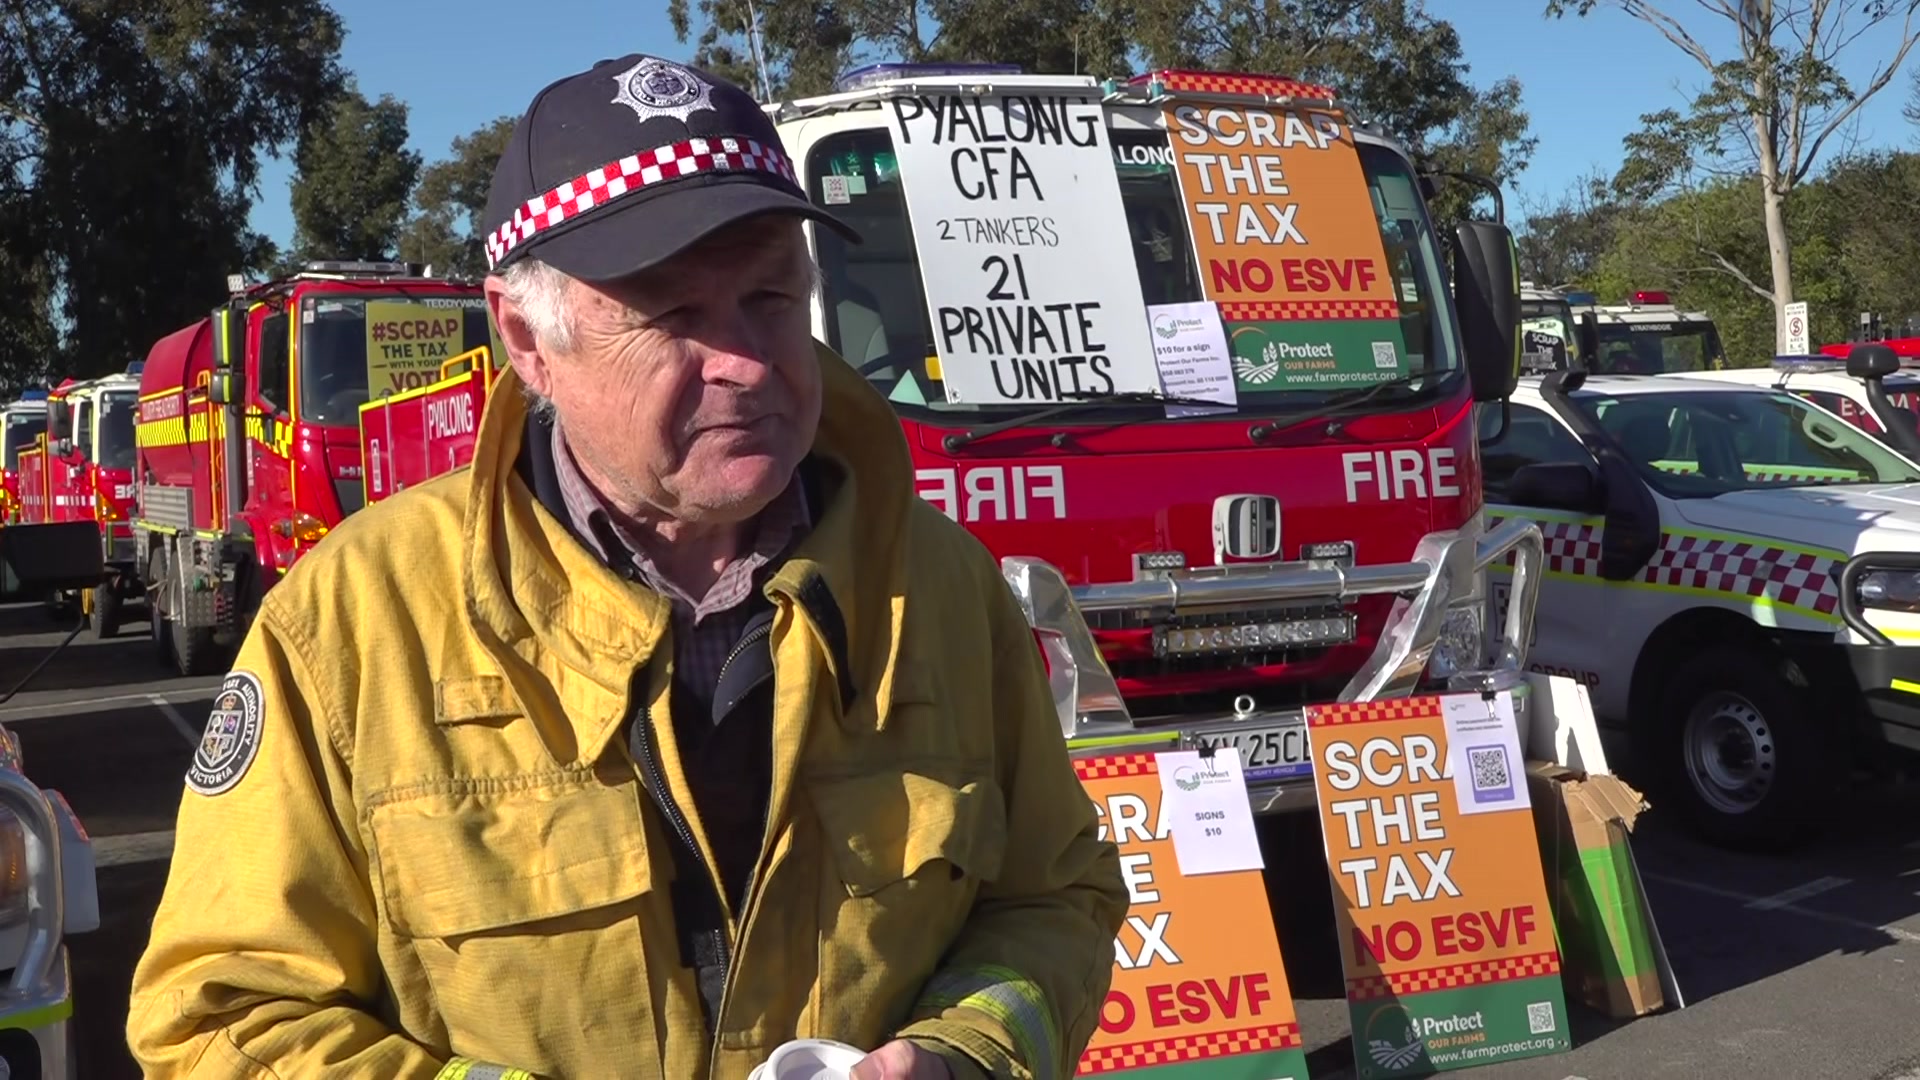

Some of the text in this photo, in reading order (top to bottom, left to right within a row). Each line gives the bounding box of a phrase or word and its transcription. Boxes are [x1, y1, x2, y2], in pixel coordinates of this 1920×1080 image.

[891, 95, 1099, 147] PYALONG
[1174, 105, 1341, 149] SCRAP
[951, 146, 1044, 201] CFA
[1183, 153, 1290, 195] THE
[936, 216, 1059, 247] 2 TANKERS
[1195, 202, 1309, 245] TAX
[981, 254, 1029, 301] 21
[1209, 259, 1376, 293] NO ESVF
[372, 319, 458, 342] #SCRAP
[938, 302, 1106, 355] PRIVATE
[381, 342, 448, 359] THE TAX
[390, 361, 414, 369] WITH
[1278, 342, 1334, 359] Protect
[1284, 360, 1336, 370] OUR FARMS
[991, 355, 1115, 402] UNITS
[428, 392, 473, 440] PYALONG
[1342, 448, 1460, 503] FIRE
[190, 764, 233, 785] VICTORIA
[1195, 810, 1225, 821] SIGNS
[1205, 826, 1222, 837] $10
[1330, 791, 1445, 849] THE
[1339, 848, 1463, 909] TAX
[1352, 905, 1536, 967] NO ESVF
[1146, 972, 1271, 1028] ESVF
[1423, 1011, 1484, 1036] Protect
[1428, 1032, 1486, 1050] OUR FARMS
[1429, 1037, 1555, 1065] www.farmprotect.org
